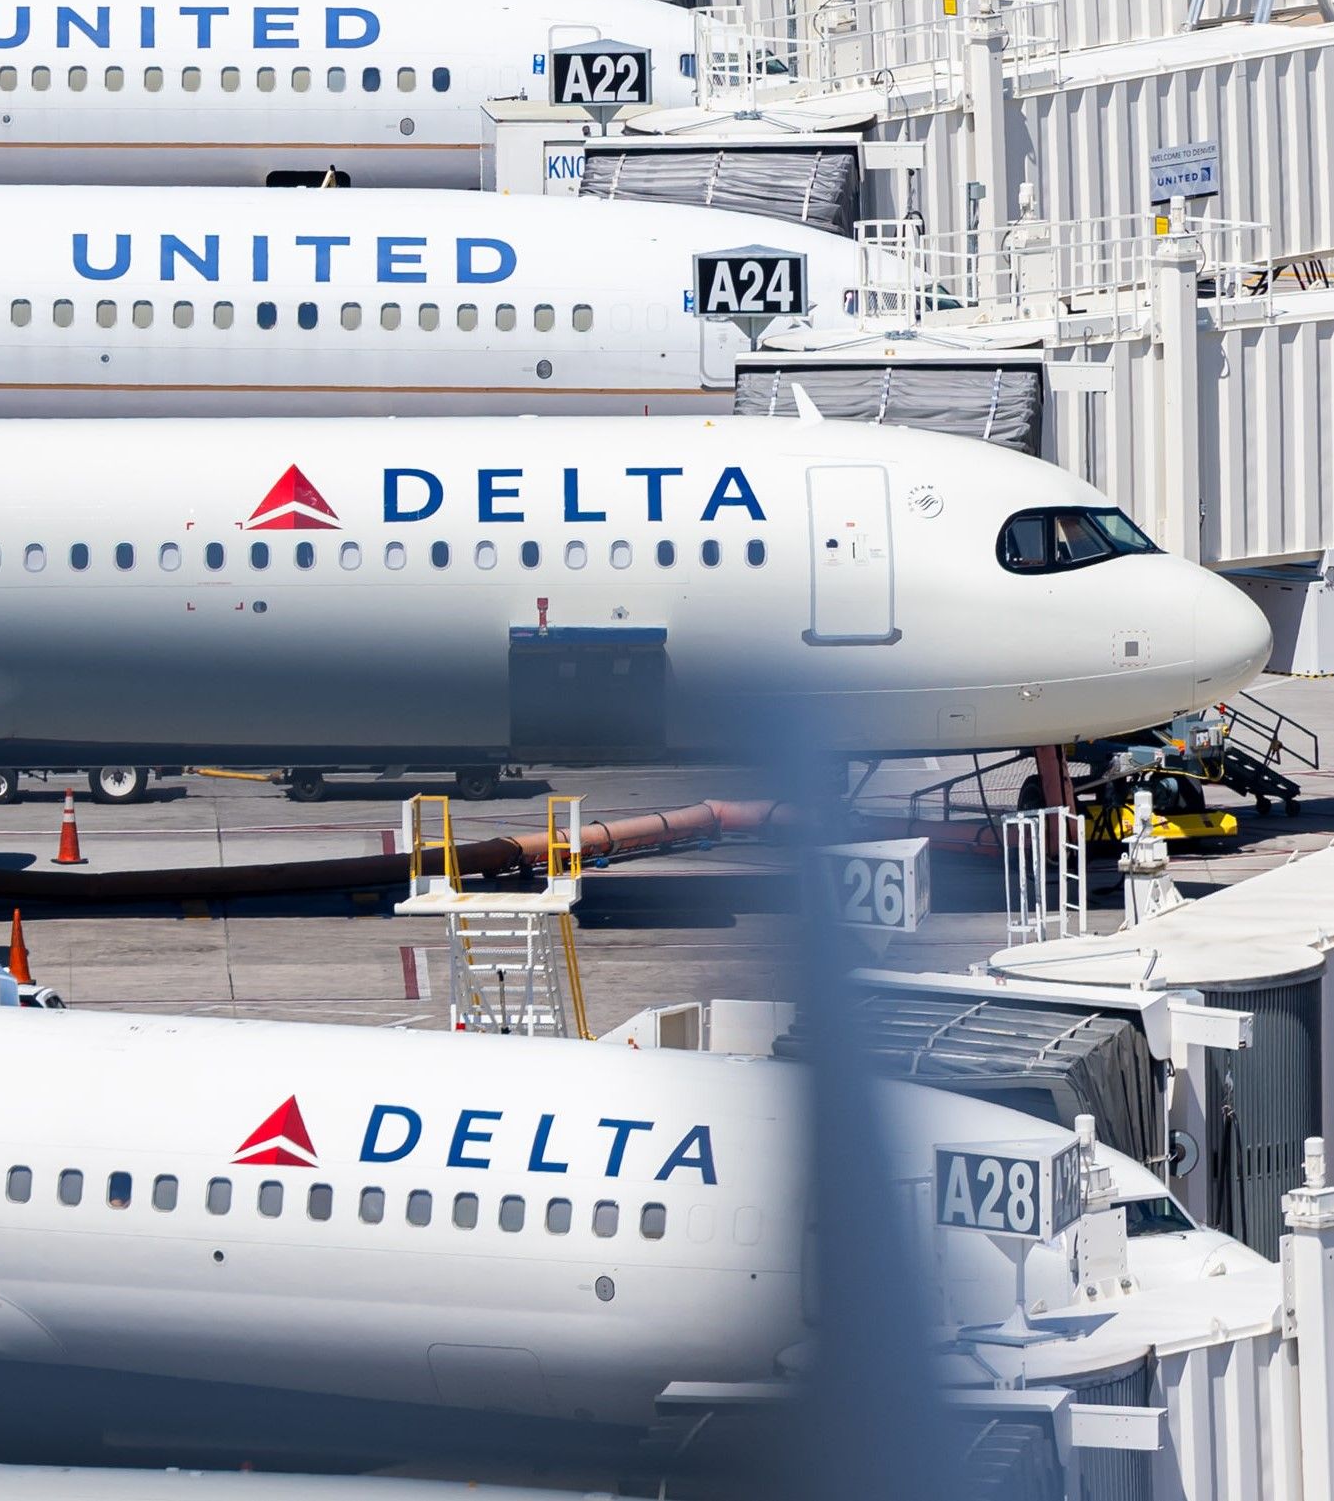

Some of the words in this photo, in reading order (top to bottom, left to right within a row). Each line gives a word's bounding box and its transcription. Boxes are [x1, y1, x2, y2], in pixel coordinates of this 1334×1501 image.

[563, 55, 639, 102] A22
[1157, 173, 1199, 187] UNITED
[73, 233, 518, 283] UNITED
[707, 260, 793, 312] A24
[383, 466, 767, 523] DELTA
[843, 858, 904, 925] 26
[359, 1105, 714, 1186] DELTA
[942, 1155, 1035, 1232] A28
